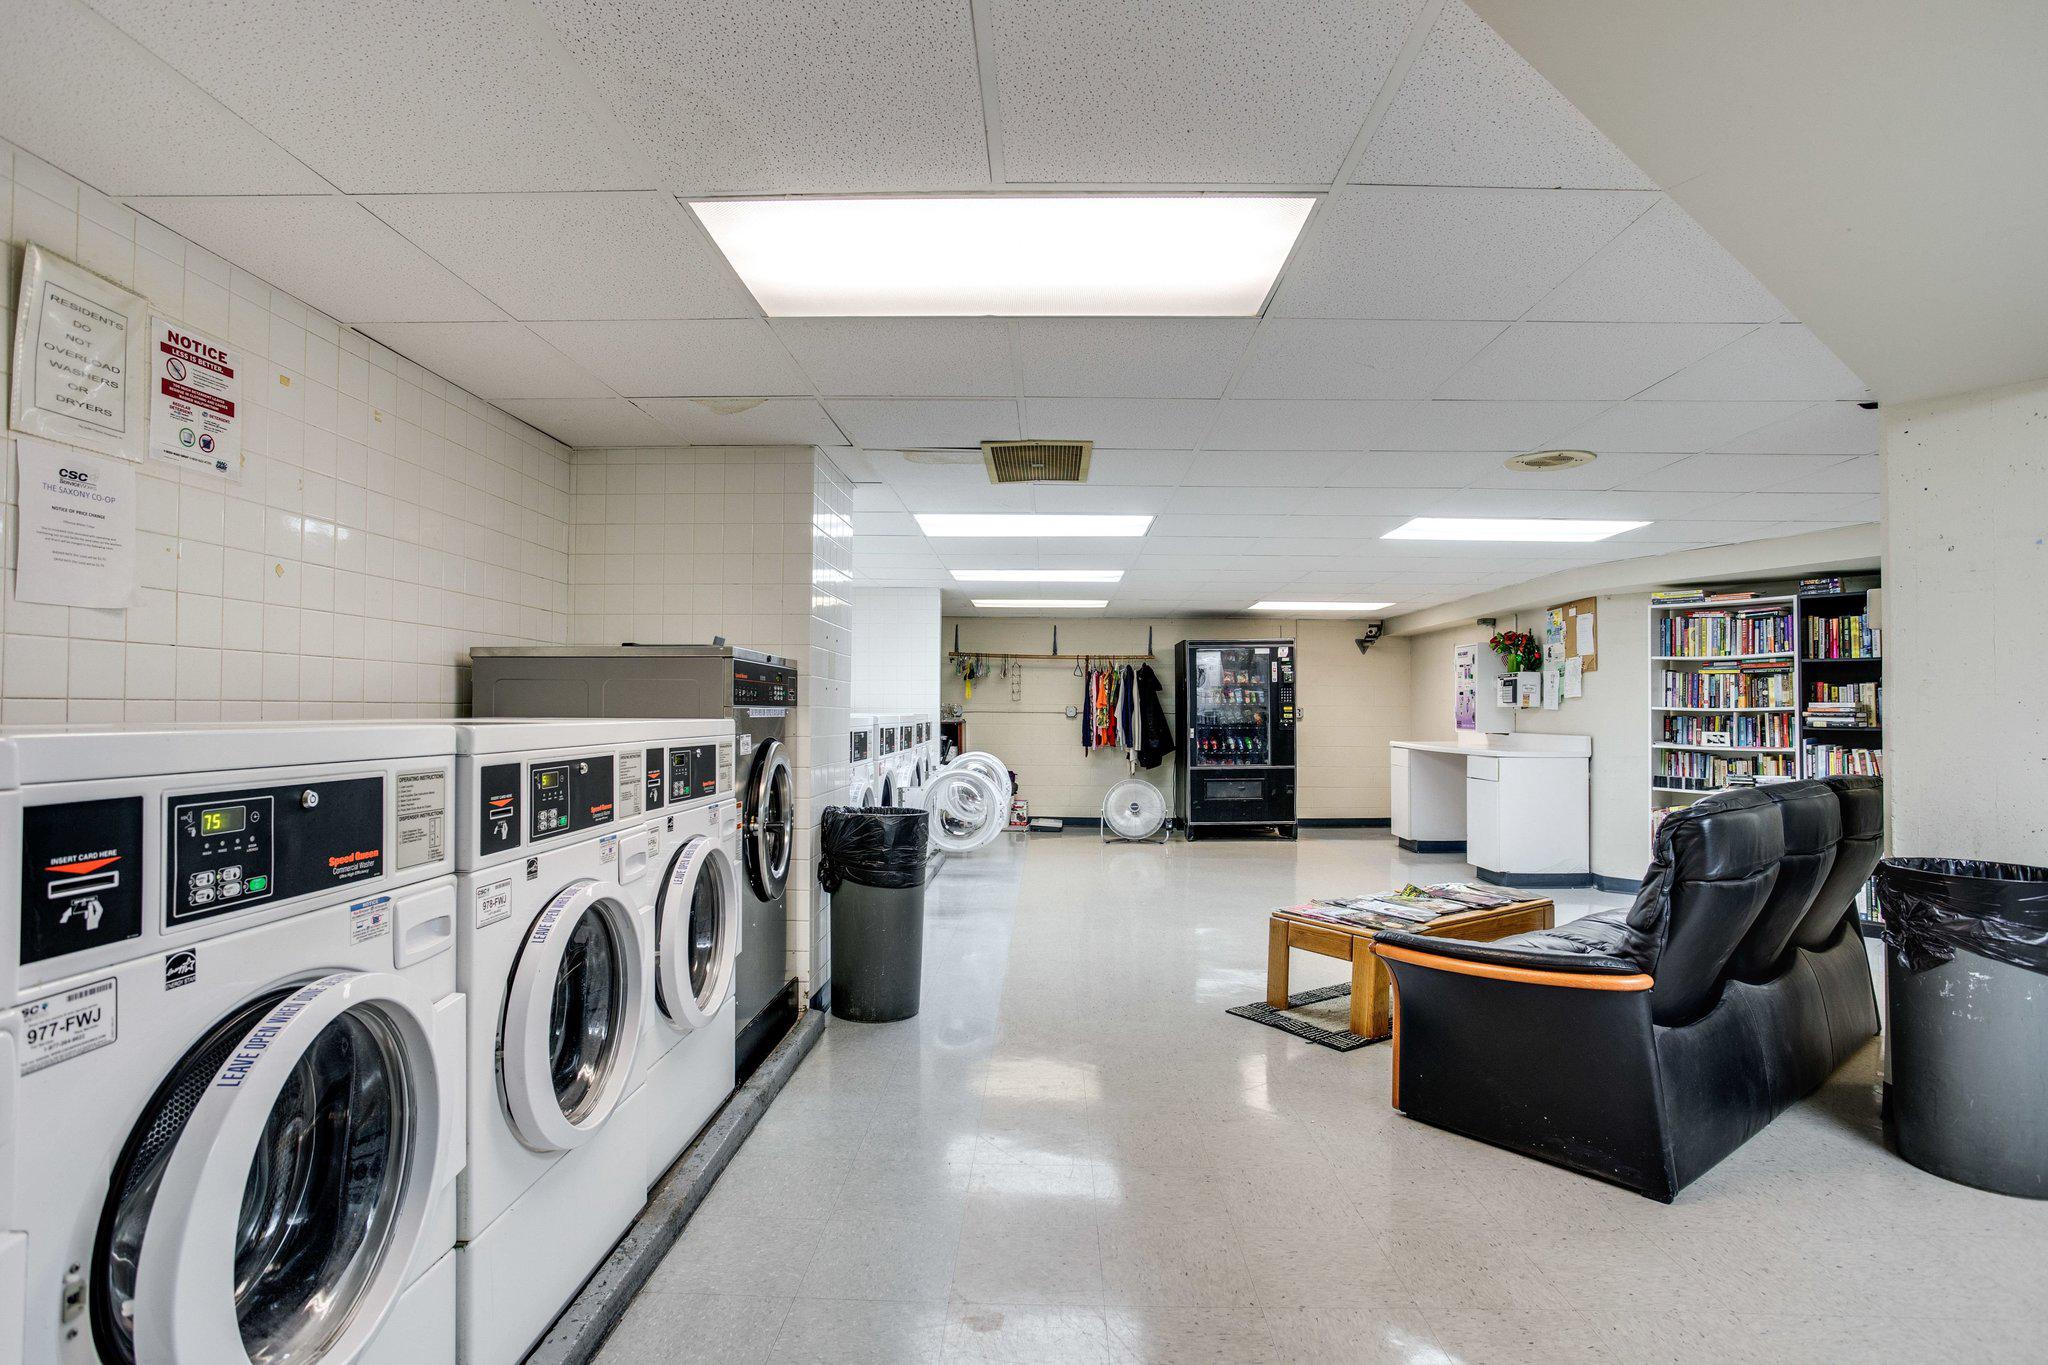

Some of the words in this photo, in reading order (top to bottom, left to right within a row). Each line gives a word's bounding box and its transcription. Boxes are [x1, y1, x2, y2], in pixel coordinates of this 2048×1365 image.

[51, 294, 124, 330] RESIDENTS
[73, 320, 91, 332] DO
[66, 334, 92, 348] NOT
[168, 330, 228, 364] NOTICE
[44, 342, 120, 374] OVERLOAD
[171, 348, 188, 360] LESS
[189, 355, 197, 363] IS
[197, 358, 224, 374] BETTER.
[49, 359, 119, 389] WASHERS
[68, 382, 88, 394] OR
[56, 394, 112, 417] DRYERS
[59, 468, 88, 481] CSC
[42, 482, 57, 492] THE
[58, 486, 90, 499] SAXONY
[92, 493, 116, 503] CO-OP
[51, 505, 68, 513] NOTICE
[204, 813, 222, 830] 75
[50, 855, 77, 865] INSERT
[78, 852, 98, 861] CARD
[99, 849, 117, 858] HERE
[329, 852, 355, 867] Speed
[355, 850, 379, 861] Queen
[332, 862, 359, 875] Commercial
[21, 1005, 39, 1017] SC
[27, 1007, 101, 1044] 977-FWJ
[216, 1053, 260, 1087] LEAVE
[243, 1026, 281, 1050] OPEN
[266, 1002, 306, 1024] WHEN
